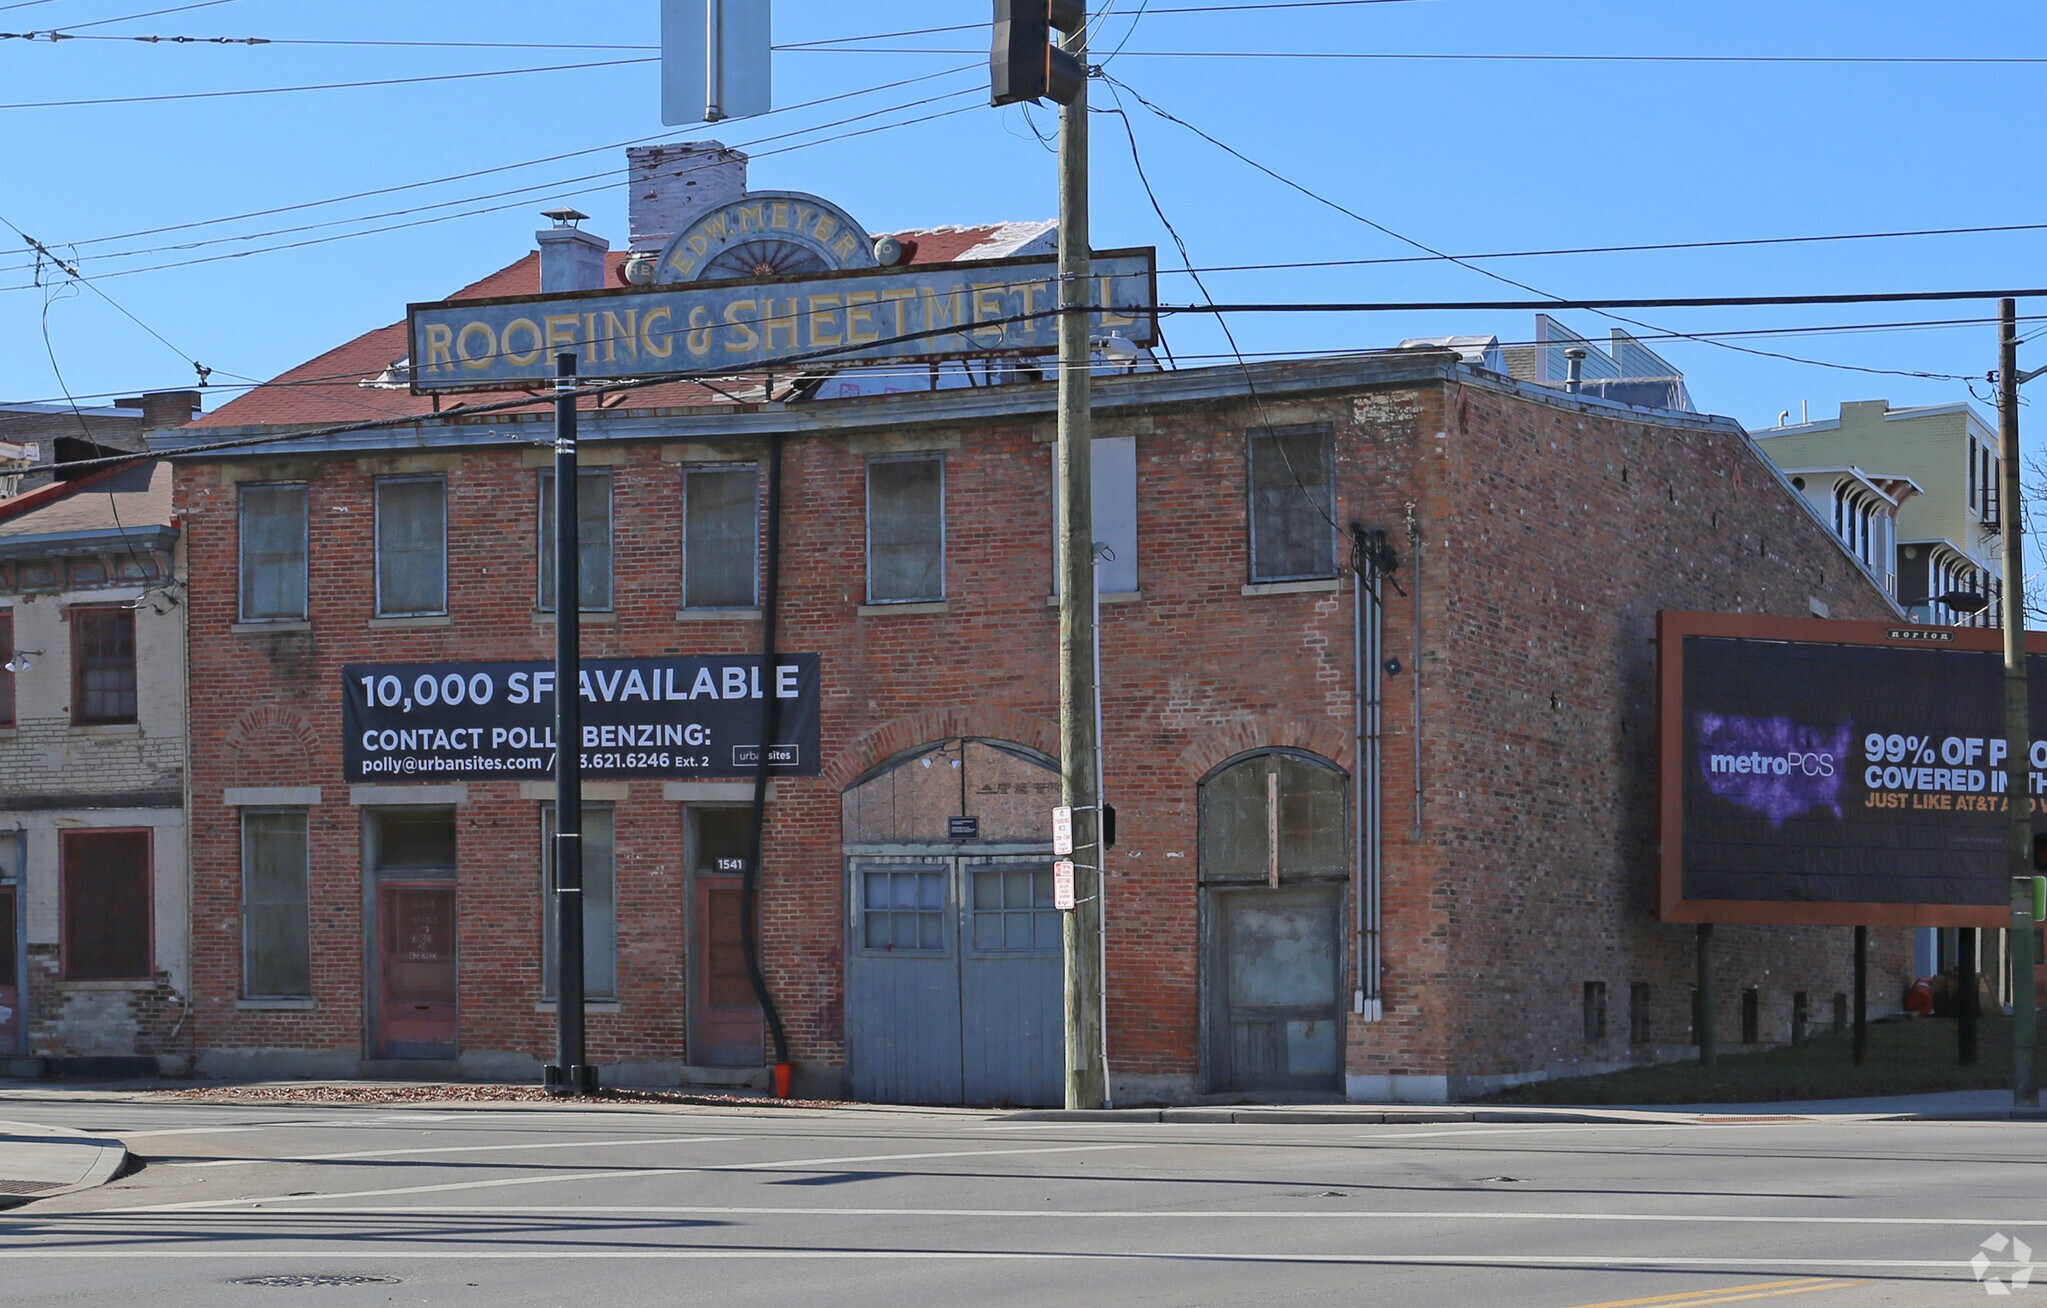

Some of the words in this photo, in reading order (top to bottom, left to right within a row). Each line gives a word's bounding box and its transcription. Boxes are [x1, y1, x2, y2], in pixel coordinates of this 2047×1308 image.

[424, 305, 673, 374] ROOFING
[685, 305, 713, 356] &
[1891, 631, 1949, 640] norton
[360, 672, 494, 713] 10,000
[507, 671, 556, 704] SF
[578, 665, 799, 702] AVAILABLE
[362, 728, 484, 752] CONTACT
[492, 726, 557, 749] POLL
[582, 723, 711, 748] BENZING:
[362, 755, 542, 775] polly@urbansites.com
[580, 752, 670, 769] 3.621.6246
[675, 756, 699, 767] Ext.
[701, 756, 709, 767] 2
[1711, 751, 1834, 777] metroPCS
[1864, 733, 1936, 764] 99%
[1941, 736, 1984, 766] OF
[1989, 738, 2047, 769] PO
[1864, 765, 1985, 792] COVERED
[1864, 792, 1909, 809] JUST
[1912, 794, 1952, 811] LIKE
[1957, 795, 1999, 812] AT&T
[718, 859, 742, 869] 1541
